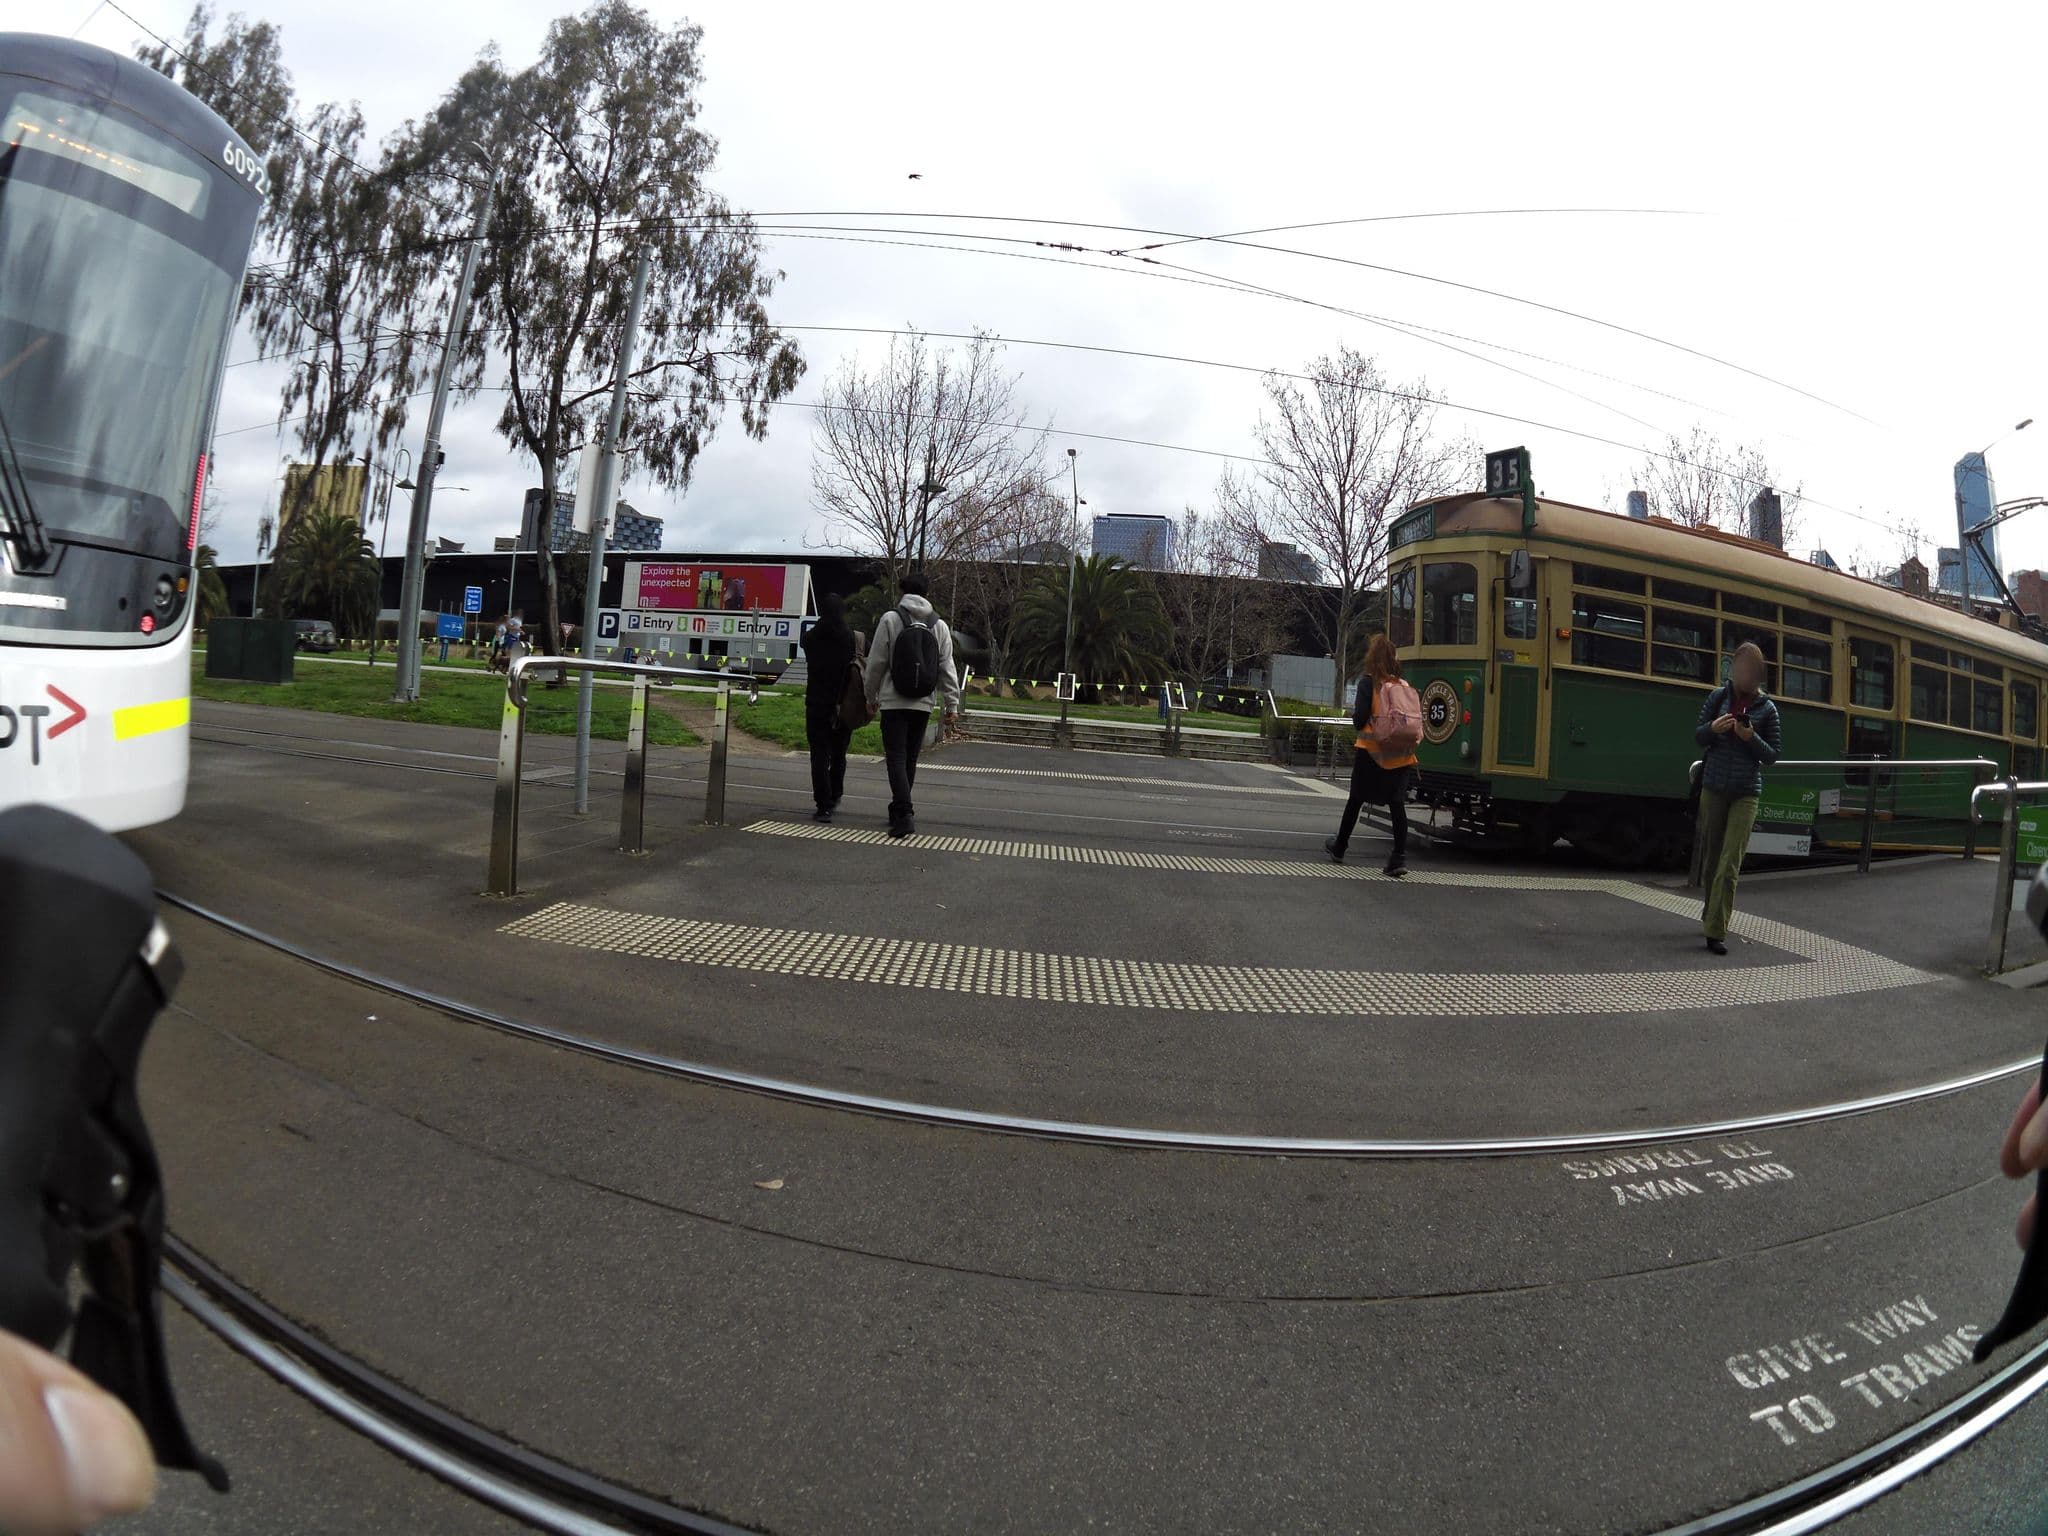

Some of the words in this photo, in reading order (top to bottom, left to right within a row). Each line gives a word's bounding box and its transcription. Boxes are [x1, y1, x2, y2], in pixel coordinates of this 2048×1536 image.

[222, 140, 265, 195] 6092
[1492, 458, 1519, 488] 35
[641, 578, 692, 589] unexpected
[642, 565, 674, 577] Explore
[677, 566, 691, 576] the
[643, 616, 674, 632] Entry
[737, 621, 772, 637] Entry
[1430, 704, 1445, 720] 35
[1763, 806, 1785, 819] Street
[1561, 1148, 1714, 1180] TRAMS
[1706, 1163, 1796, 1190] GIVE
[1610, 1176, 1705, 1206] WAY
[1725, 1332, 1847, 1390] GIVE
[1845, 1294, 1938, 1345] WAY
[1750, 1394, 1837, 1446] TO
[1840, 1324, 1984, 1408] TRAMS
